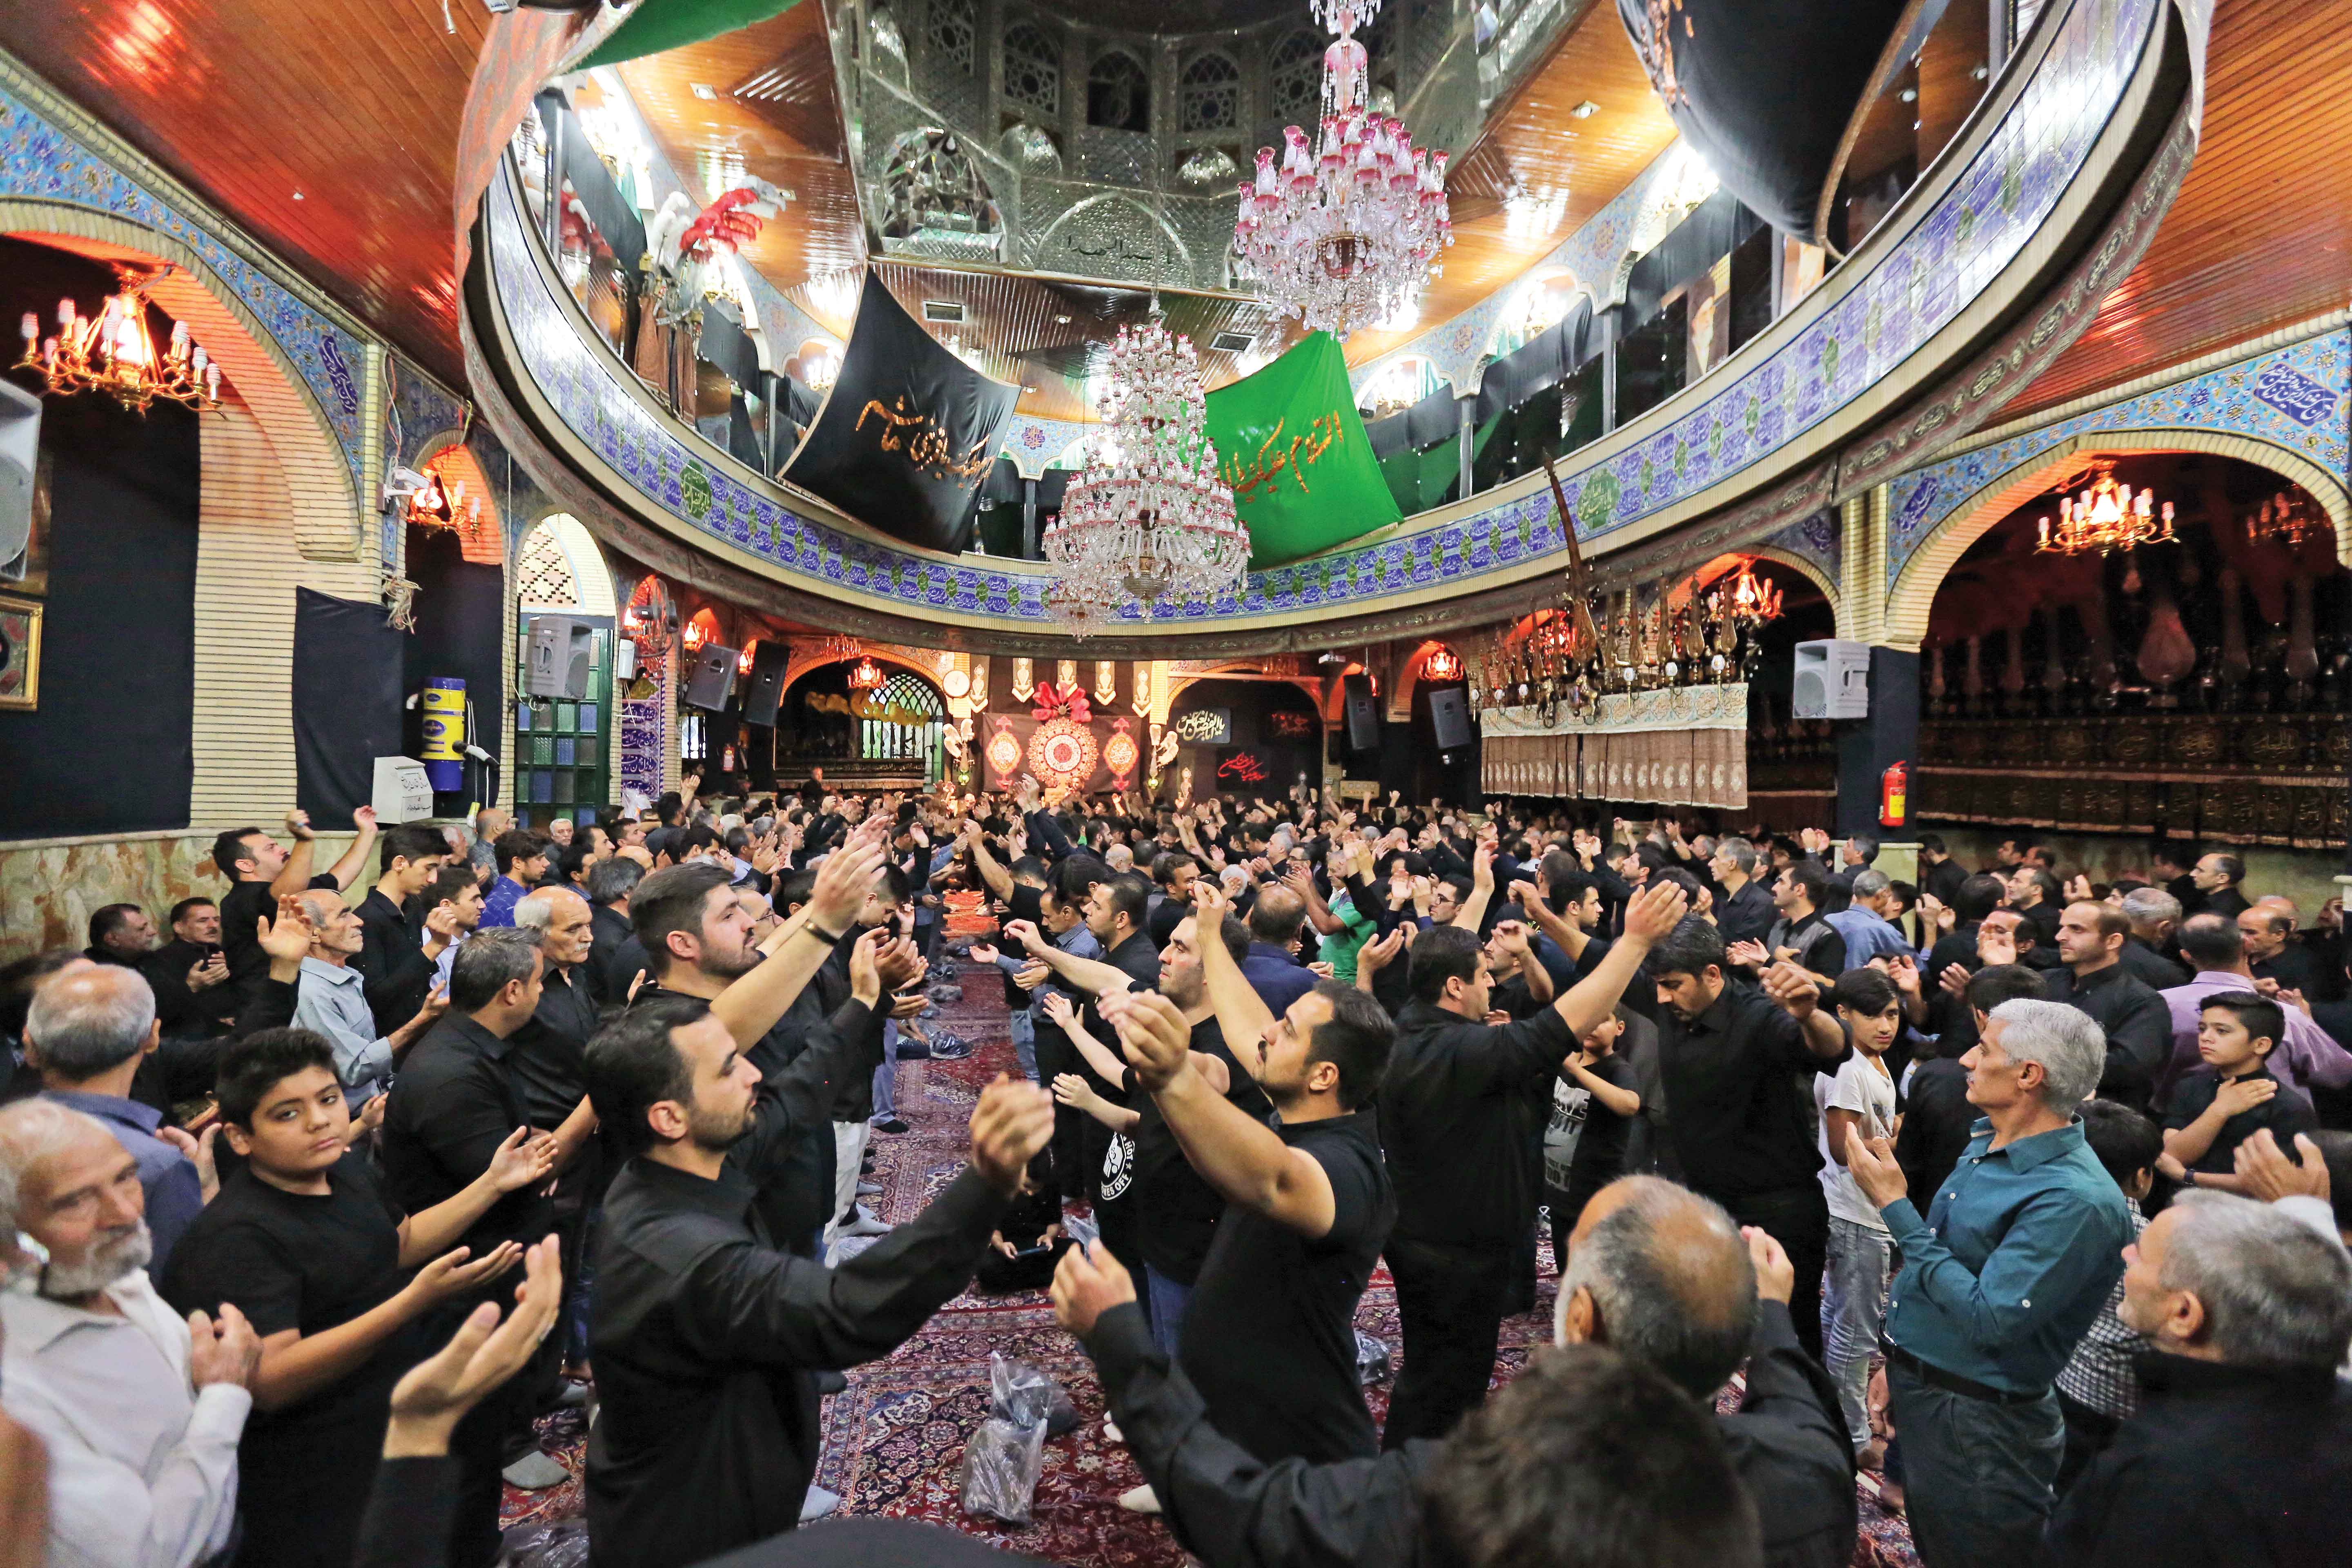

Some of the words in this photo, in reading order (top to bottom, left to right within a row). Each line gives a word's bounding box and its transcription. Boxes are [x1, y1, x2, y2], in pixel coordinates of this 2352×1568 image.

[1290, 410, 1344, 494] السلام
[1124, 1140, 1134, 1160] HOT
[1115, 1173, 1129, 1191] OFF
